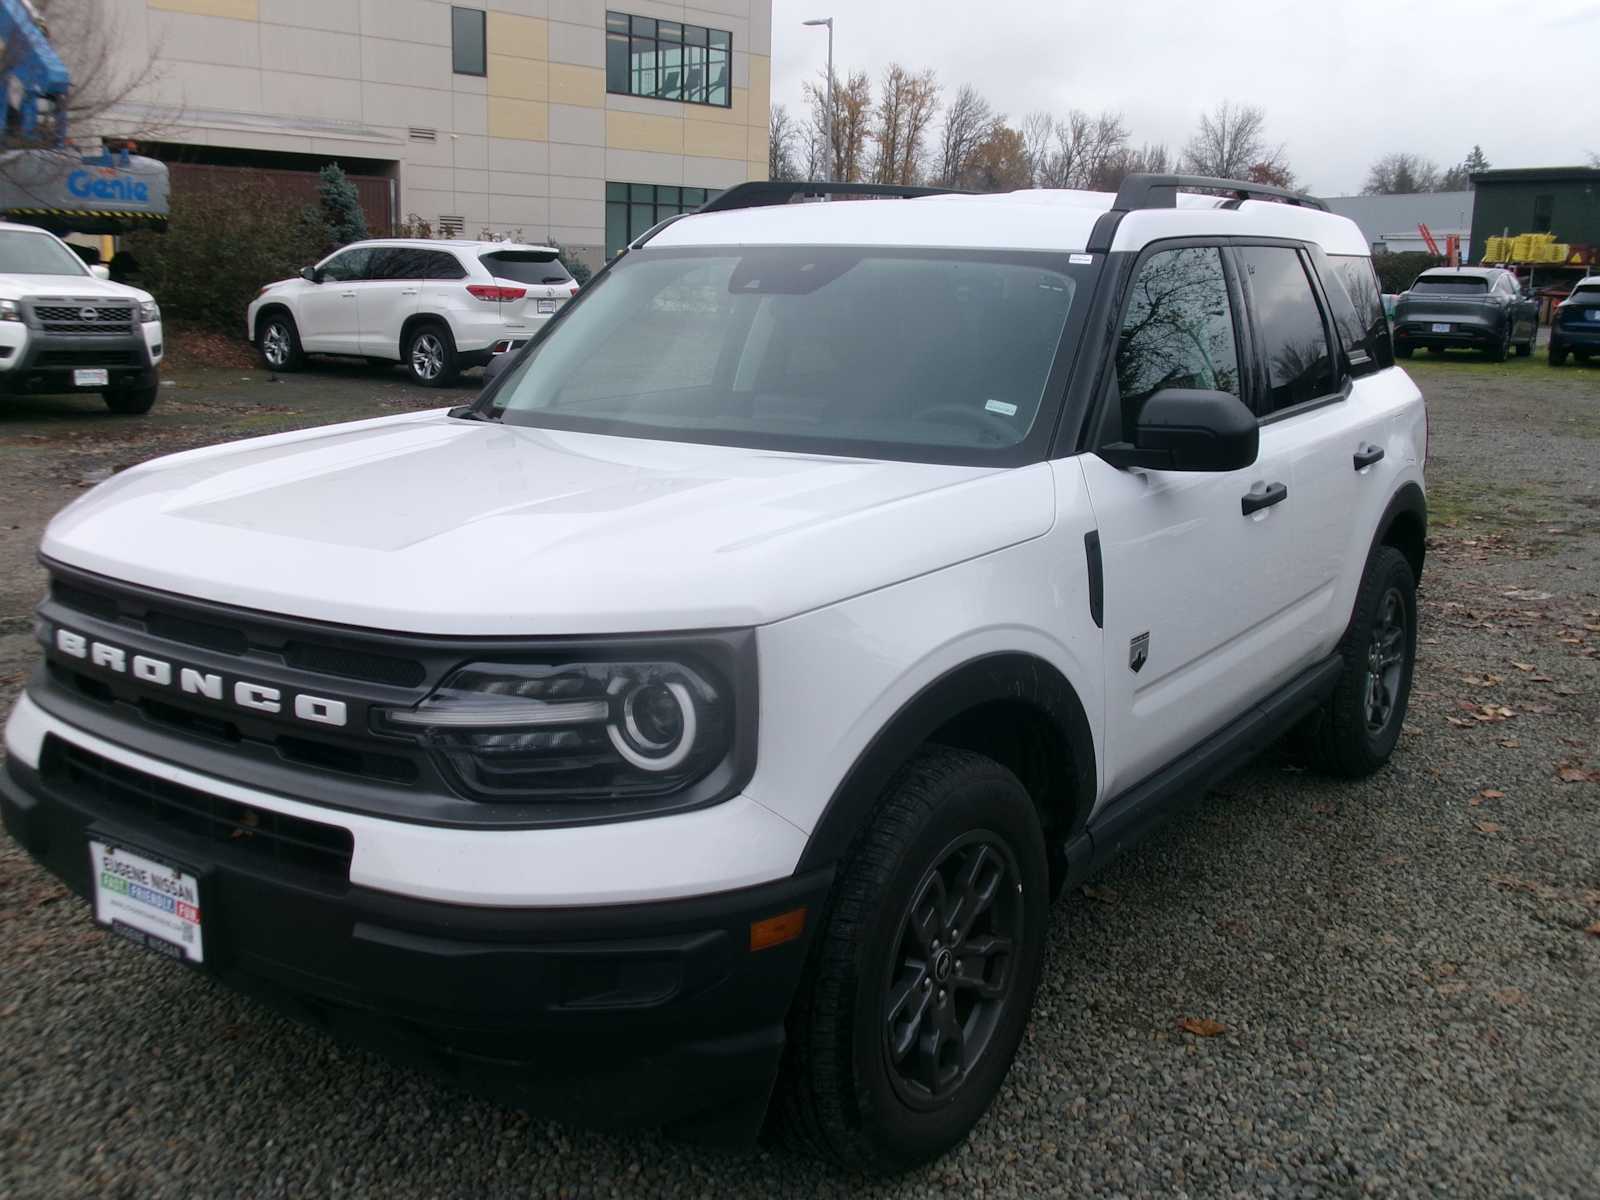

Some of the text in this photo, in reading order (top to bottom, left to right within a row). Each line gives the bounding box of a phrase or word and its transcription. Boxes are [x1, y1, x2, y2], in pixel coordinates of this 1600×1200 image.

[67, 170, 148, 201] Genie
[57, 629, 347, 726] BRONCO
[103, 856, 193, 904] EUGENE NISSAN
